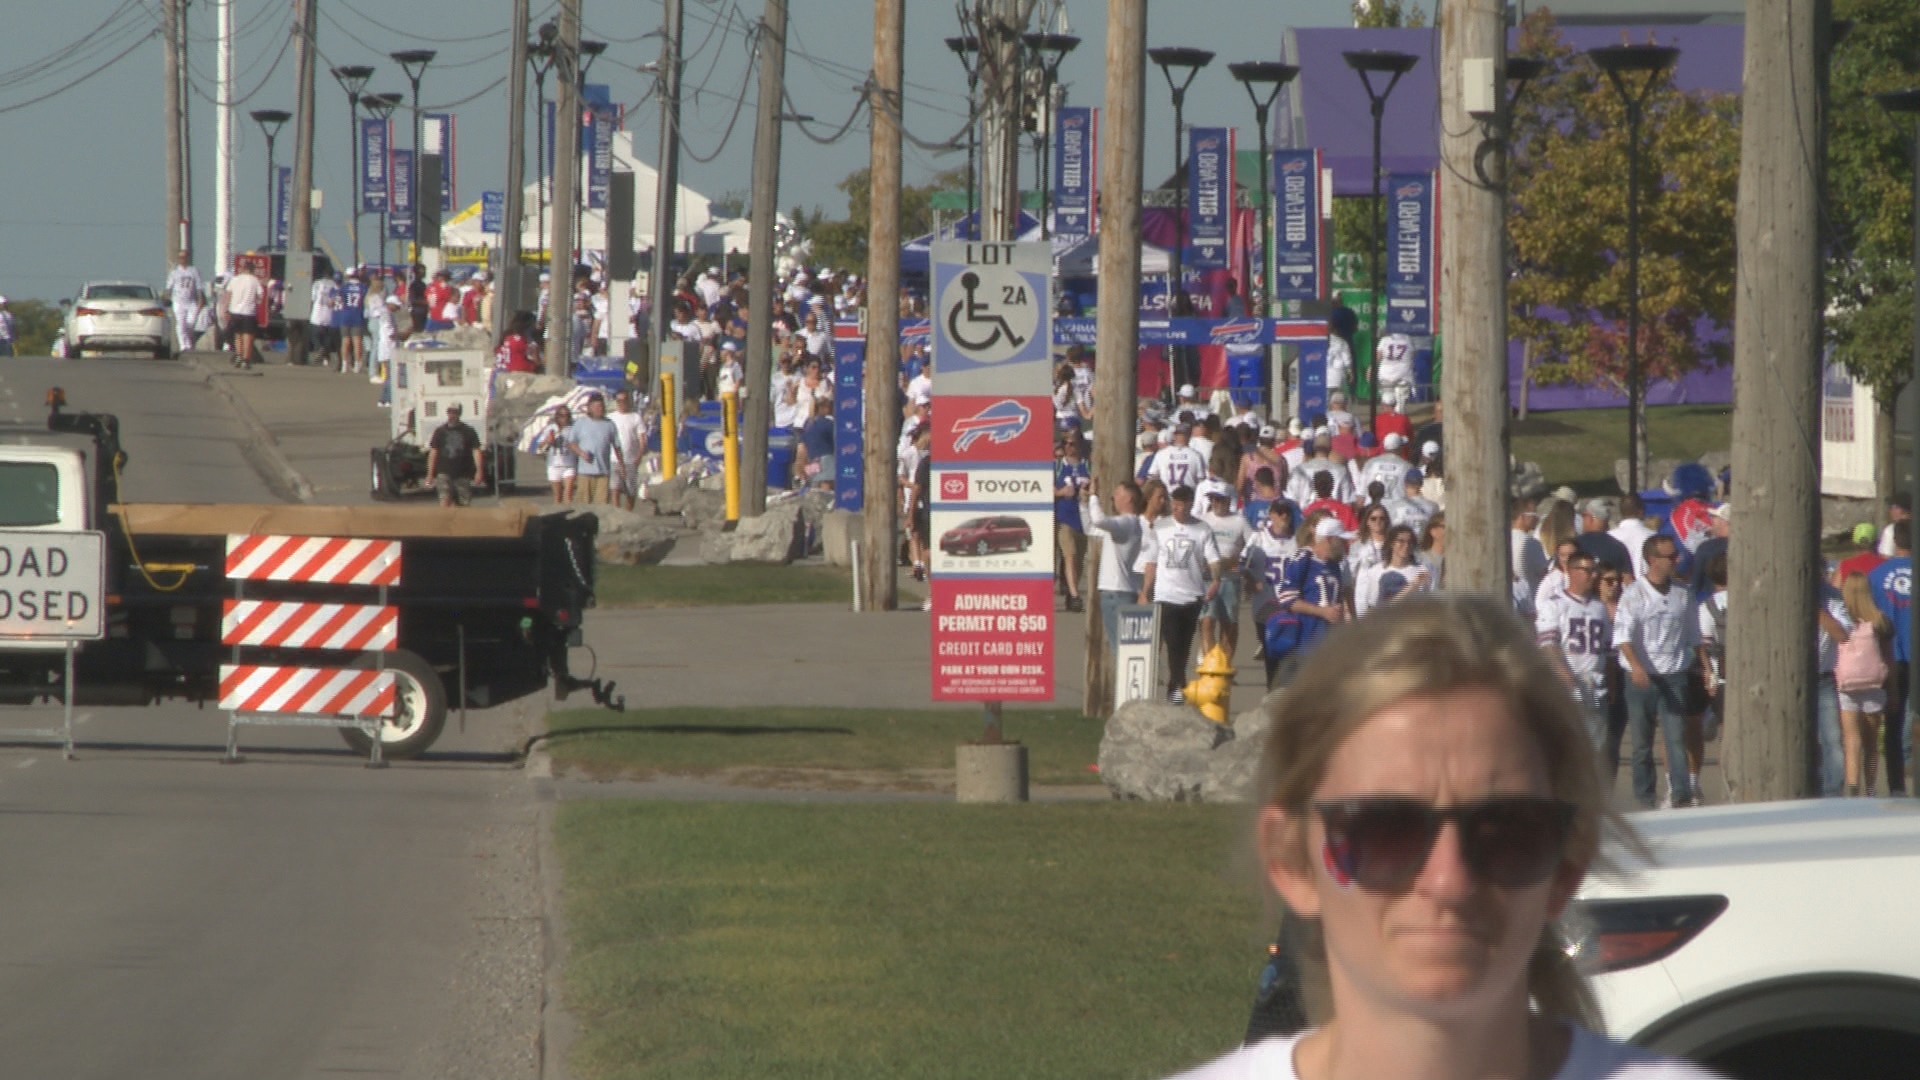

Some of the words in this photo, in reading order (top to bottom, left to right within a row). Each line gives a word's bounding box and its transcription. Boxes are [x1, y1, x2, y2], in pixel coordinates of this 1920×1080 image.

[1063, 130, 1082, 187] BILLEVARD
[1198, 152, 1218, 215] BILLEVARD
[1285, 175, 1307, 241] BILLEVARD
[1398, 201, 1421, 273] BILLEVARD
[966, 244, 1017, 265] LOT
[1002, 285, 1027, 306] 2A
[1387, 344, 1407, 361] 17
[975, 480, 1042, 493] TOYOTA
[1168, 463, 1190, 487] 17
[1165, 538, 1197, 569] 17
[955, 594, 1028, 611] ADVANCED
[1315, 576, 1340, 608] 17
[939, 615, 995, 632] PERMIT
[997, 615, 1017, 631] OR
[1019, 613, 1047, 633] $50
[1569, 617, 1604, 655] 58
[939, 641, 980, 656] CREDIT
[983, 641, 1013, 656] CARD
[1016, 641, 1044, 656] ONLY
